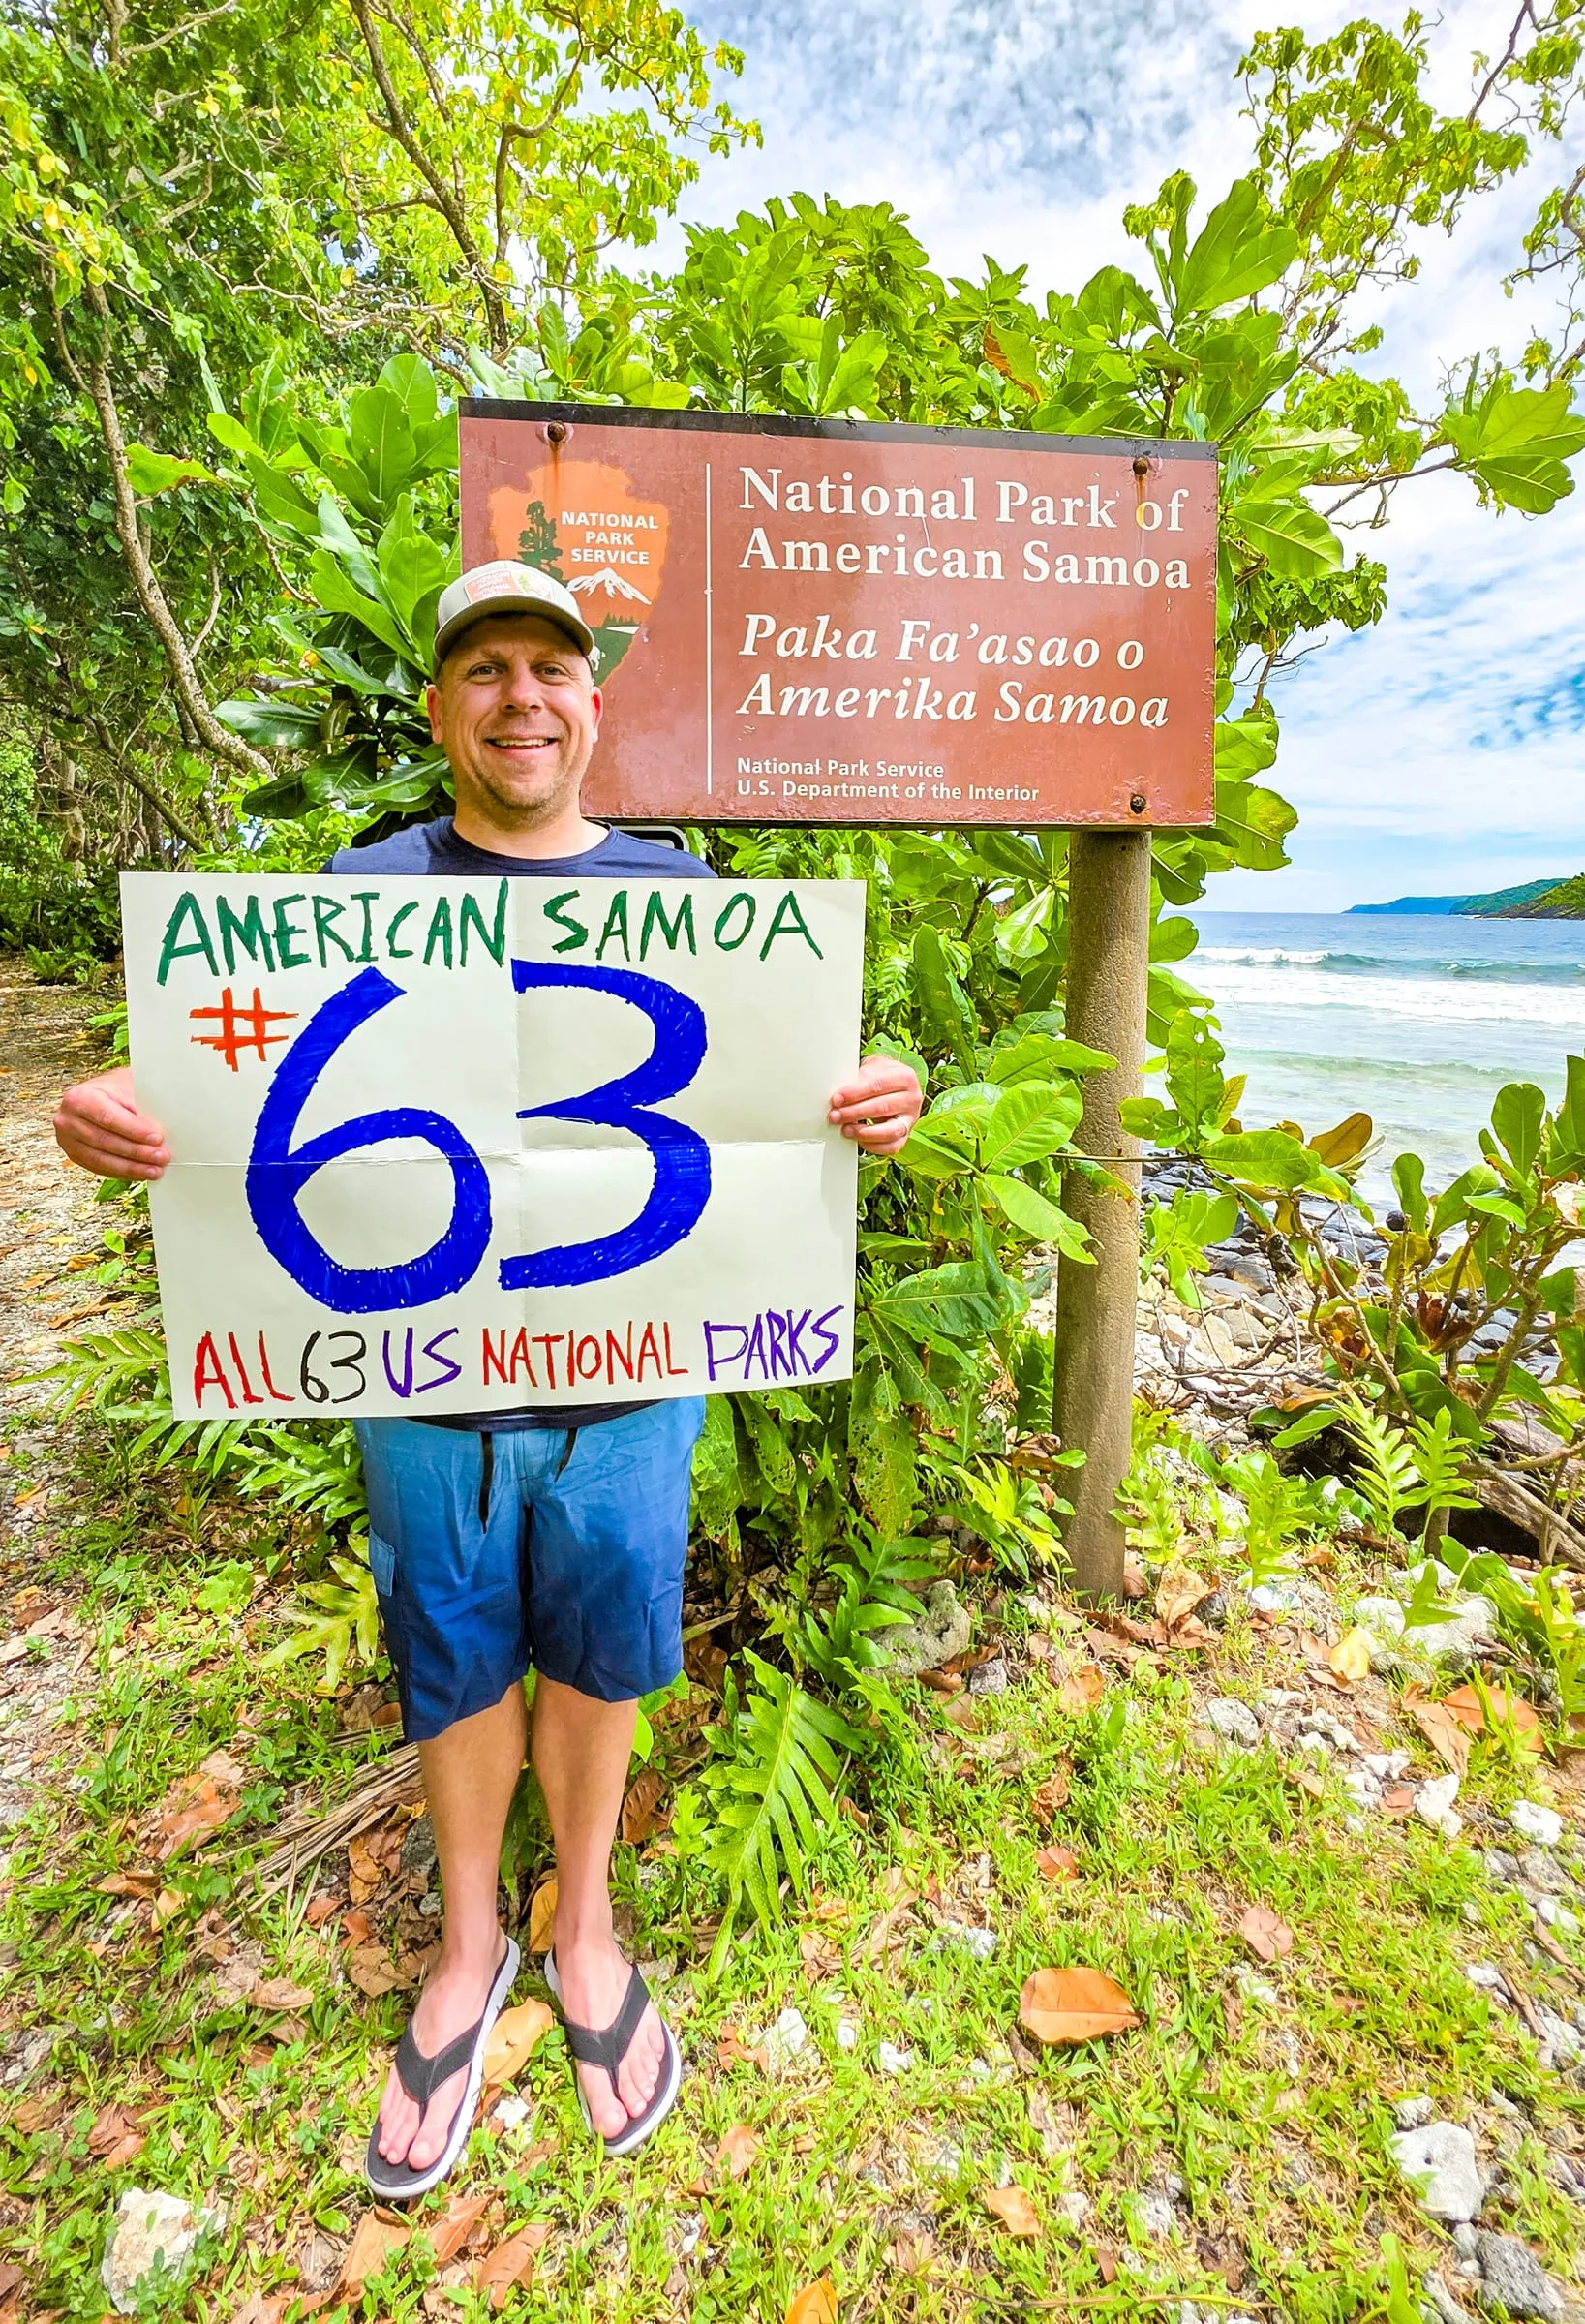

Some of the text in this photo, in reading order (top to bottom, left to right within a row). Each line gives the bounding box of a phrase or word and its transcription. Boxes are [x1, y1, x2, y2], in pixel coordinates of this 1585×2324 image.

[562, 511, 658, 529] NATIONAL
[739, 467, 1189, 532] National Park of
[571, 548, 650, 565] SERVICE
[585, 531, 634, 545] PARK
[738, 526, 1191, 589] American Samoa
[738, 613, 877, 660] Paka
[1117, 639, 1144, 670] o
[736, 673, 1169, 728] Amerika Samoa
[738, 758, 944, 778] National Park Service
[738, 780, 1039, 801] U.S. Department of the Interior
[157, 877, 824, 986] AMERICAN SAMOA
[194, 1305, 844, 1409] ALL 63 US NATIONAL PARKS
